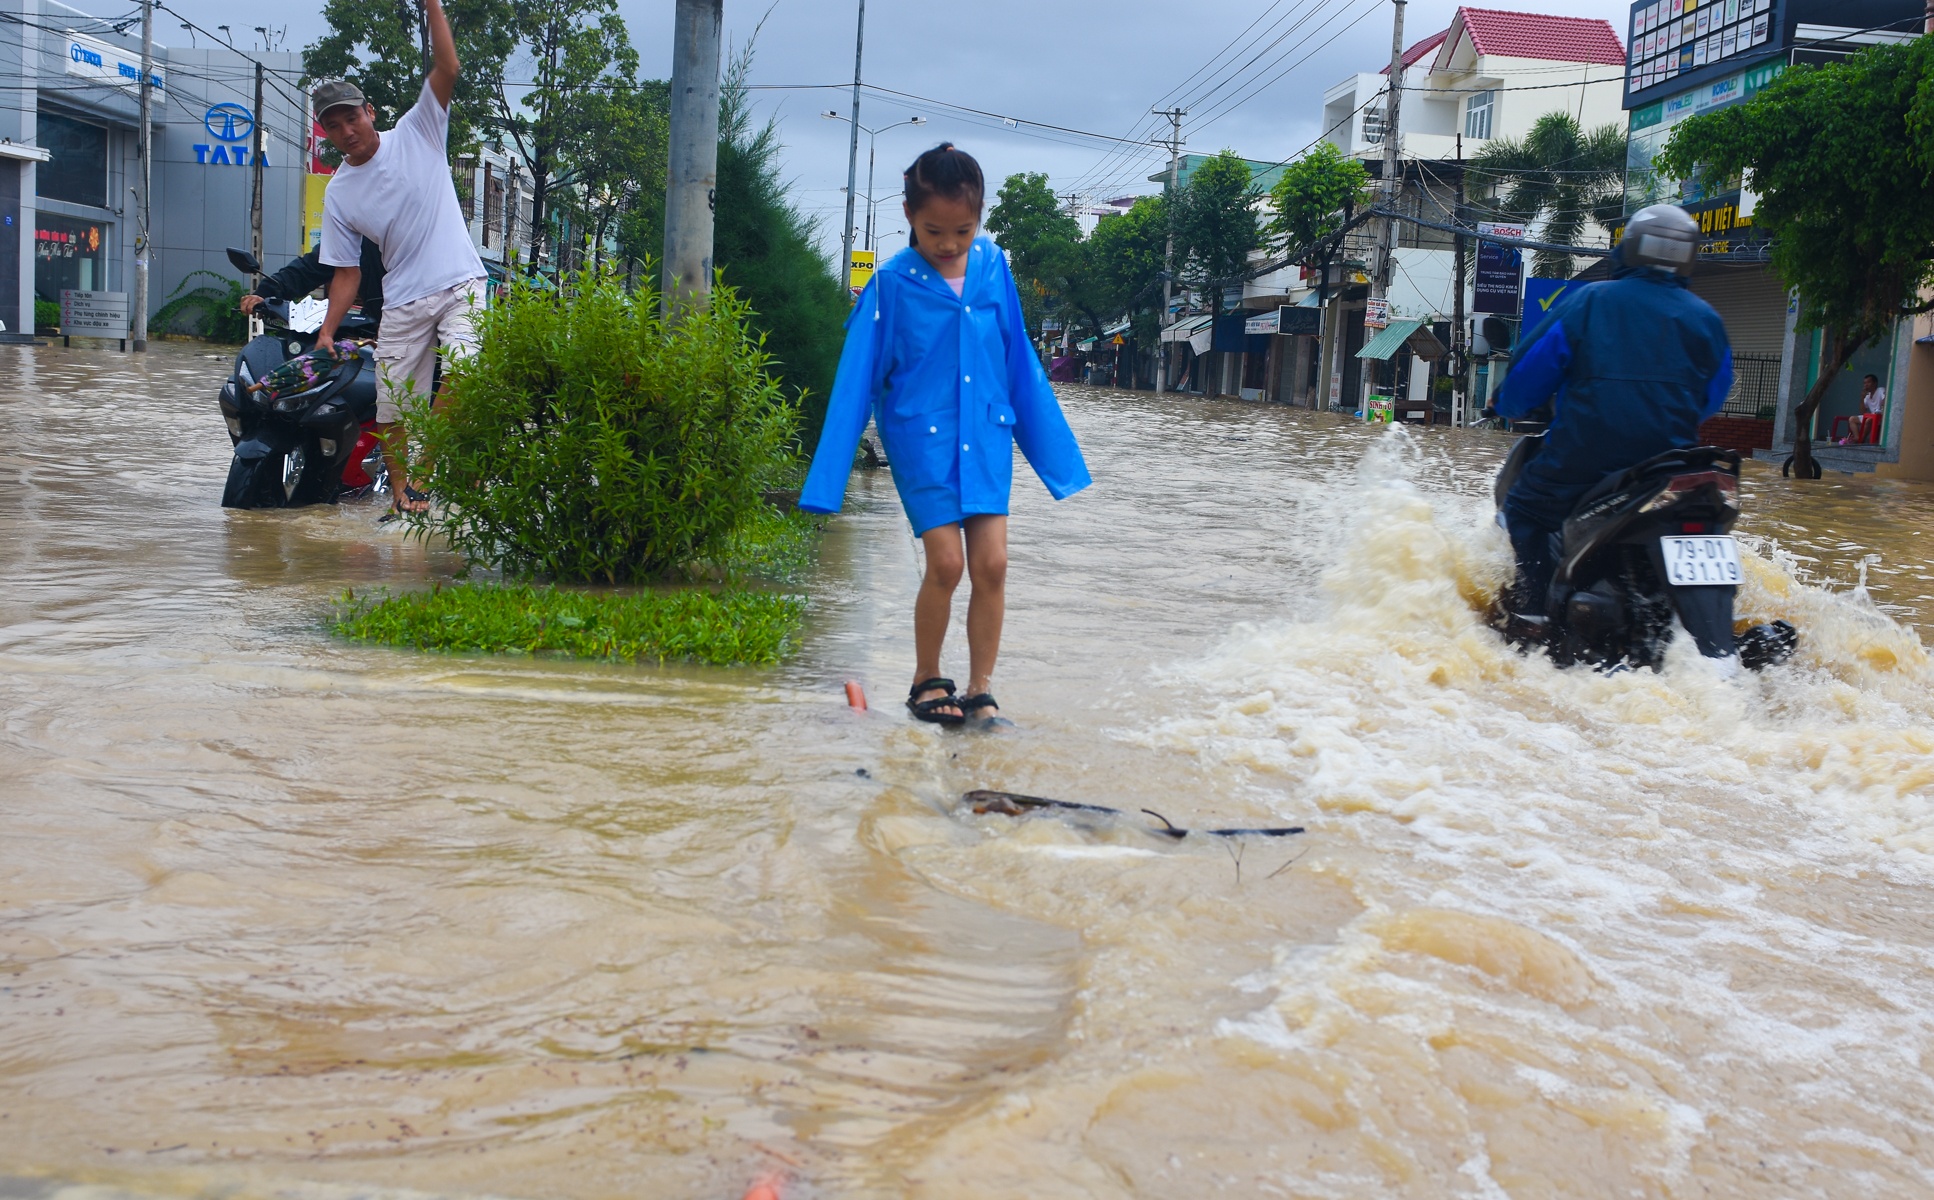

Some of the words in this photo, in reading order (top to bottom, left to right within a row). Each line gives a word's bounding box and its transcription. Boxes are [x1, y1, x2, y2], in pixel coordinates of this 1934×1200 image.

[82, 49, 102, 68] TATA
[1667, 92, 1694, 112] VinaLED
[1701, 209, 1713, 238] CỤ
[1714, 203, 1733, 236] VIỆT
[1493, 228, 1522, 237] BOSCH
[851, 261, 874, 269] XPO
[1369, 401, 1382, 410] SINH
[1673, 540, 1726, 559] 79-D1
[1673, 562, 1738, 581] 431.19
